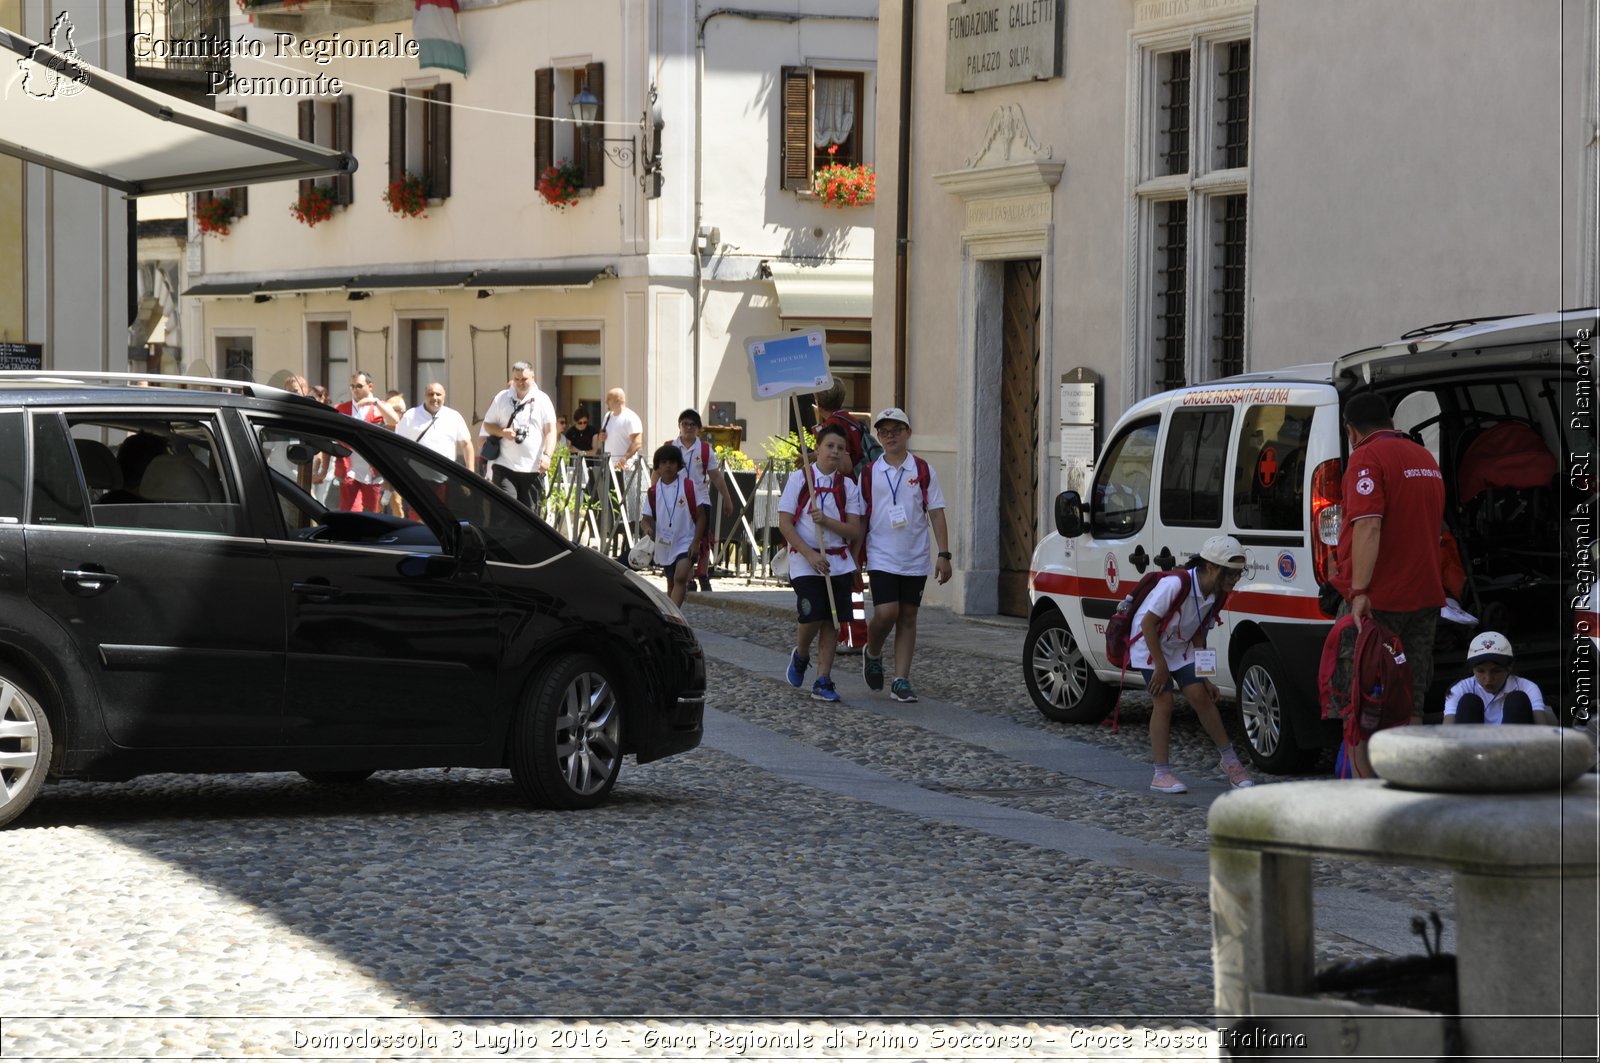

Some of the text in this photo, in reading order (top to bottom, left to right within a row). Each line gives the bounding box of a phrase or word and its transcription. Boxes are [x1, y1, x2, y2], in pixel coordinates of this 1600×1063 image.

[949, 0, 1053, 40] FONDAZIONE GALLETTI
[967, 46, 1030, 75] PALAZZO SILVA
[1183, 388, 1290, 405] CROCE ROSSA ITALIANA
